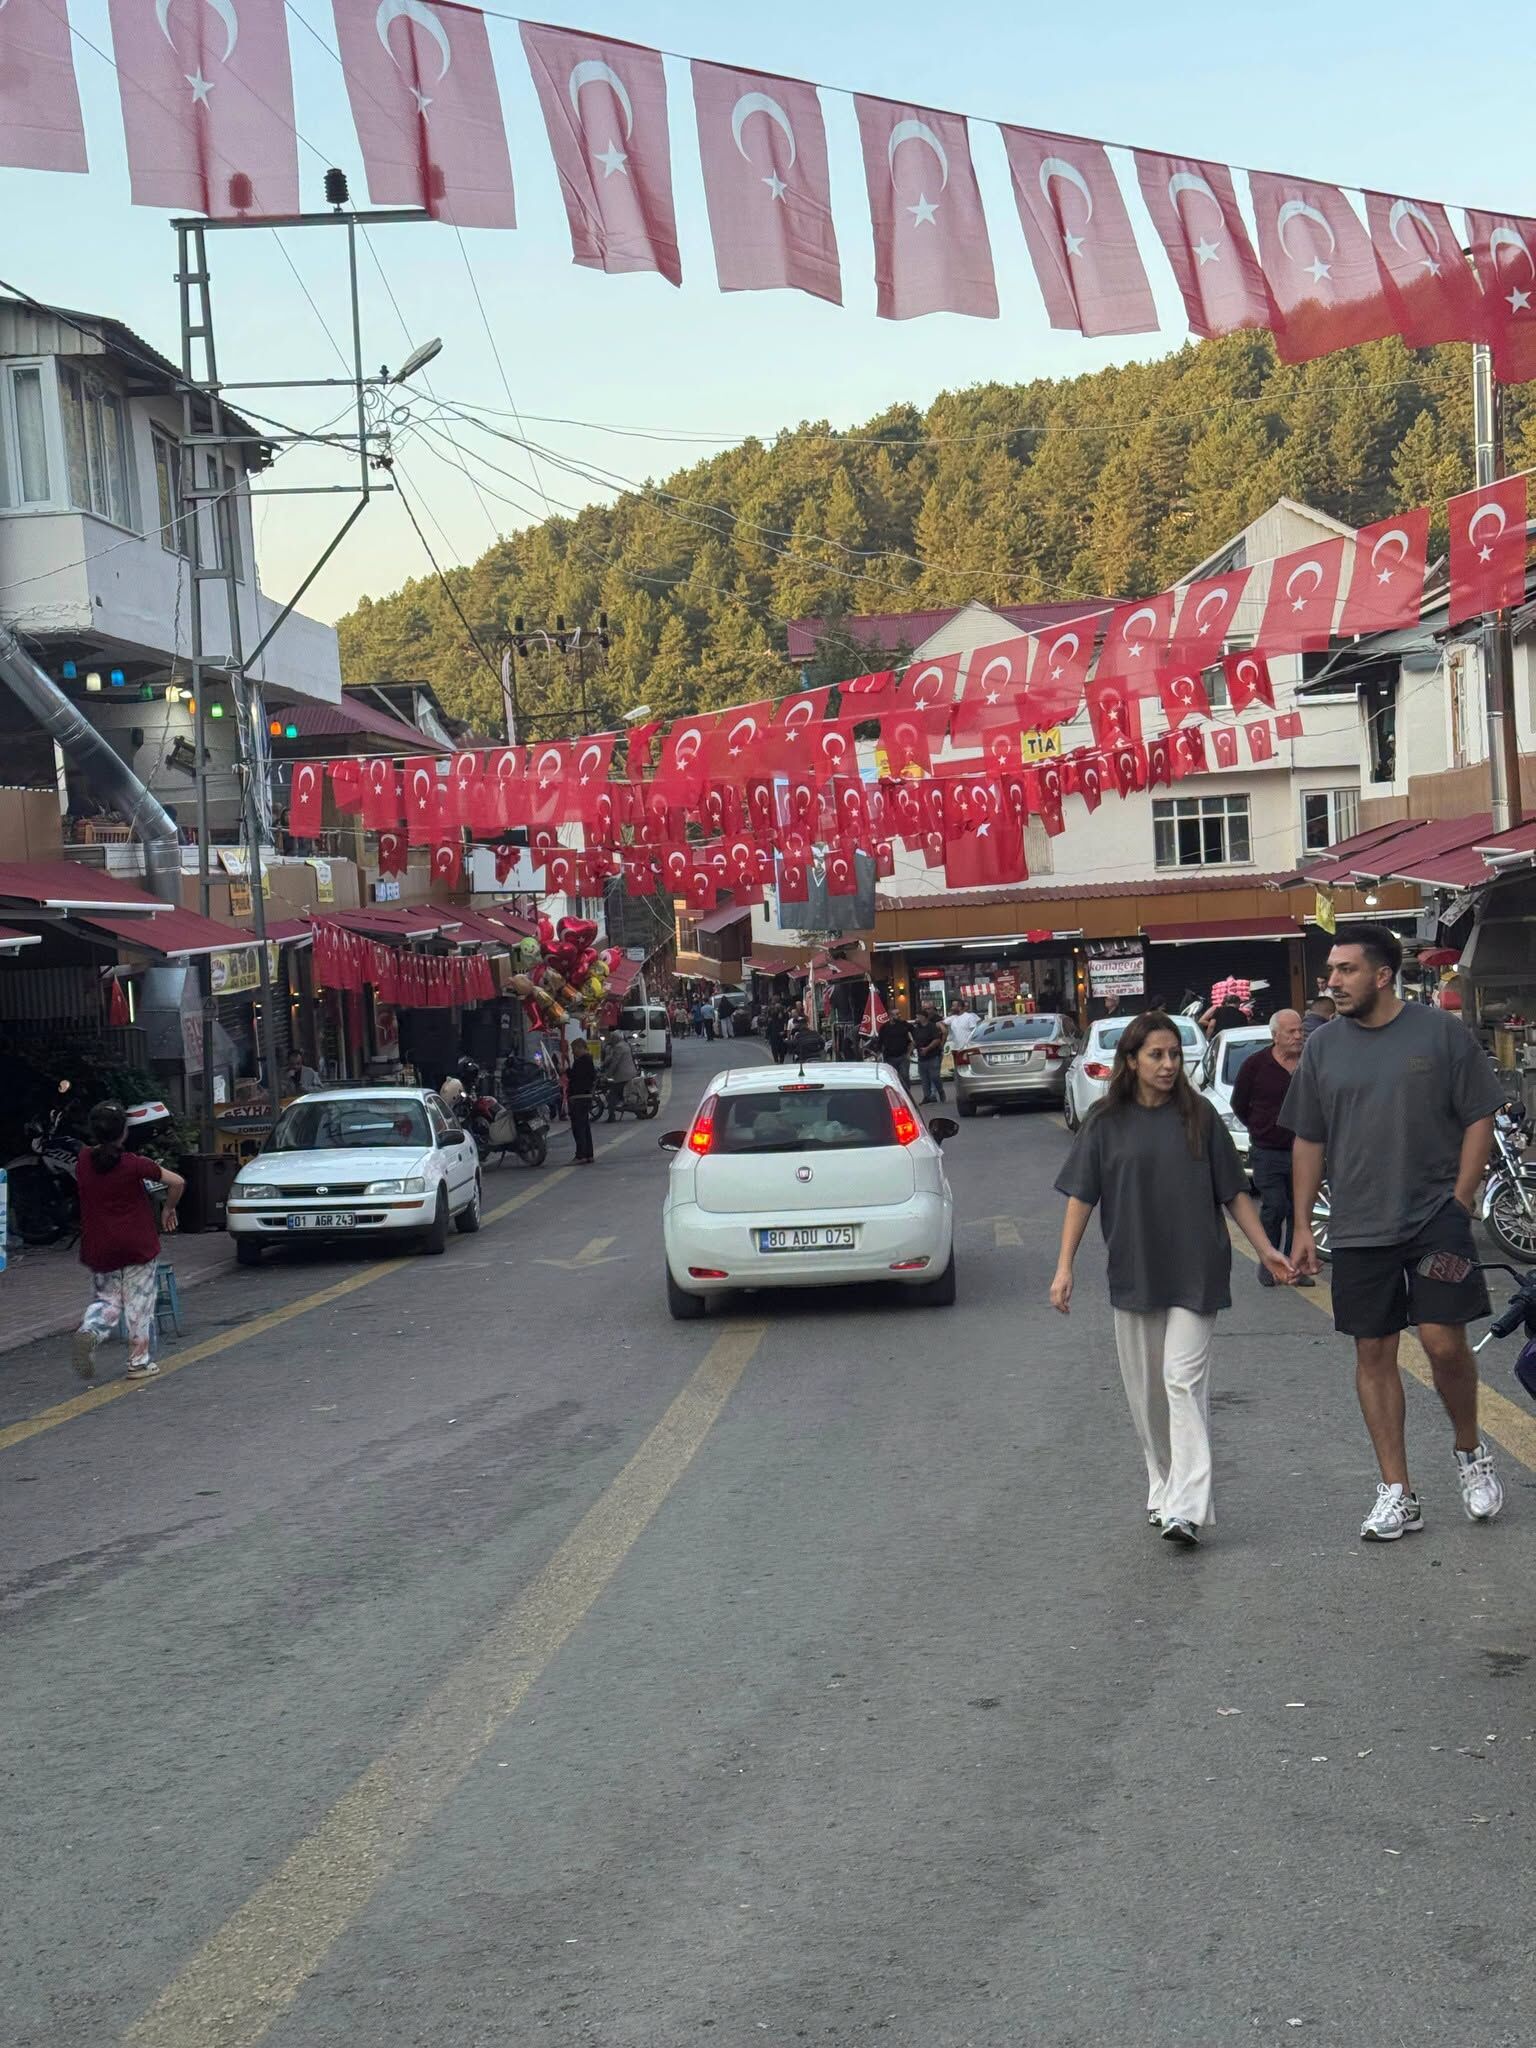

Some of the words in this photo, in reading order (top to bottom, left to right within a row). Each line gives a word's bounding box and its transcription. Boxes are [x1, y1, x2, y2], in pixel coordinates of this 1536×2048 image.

[1088, 959, 1143, 972] komagene
[224, 1106, 272, 1119] SEYHA
[294, 1215, 306, 1227] 01
[315, 1215, 333, 1227] AGR
[335, 1214, 353, 1226] 243
[769, 1231, 786, 1246] 80
[793, 1230, 818, 1245] ADU
[825, 1228, 851, 1243] 075
